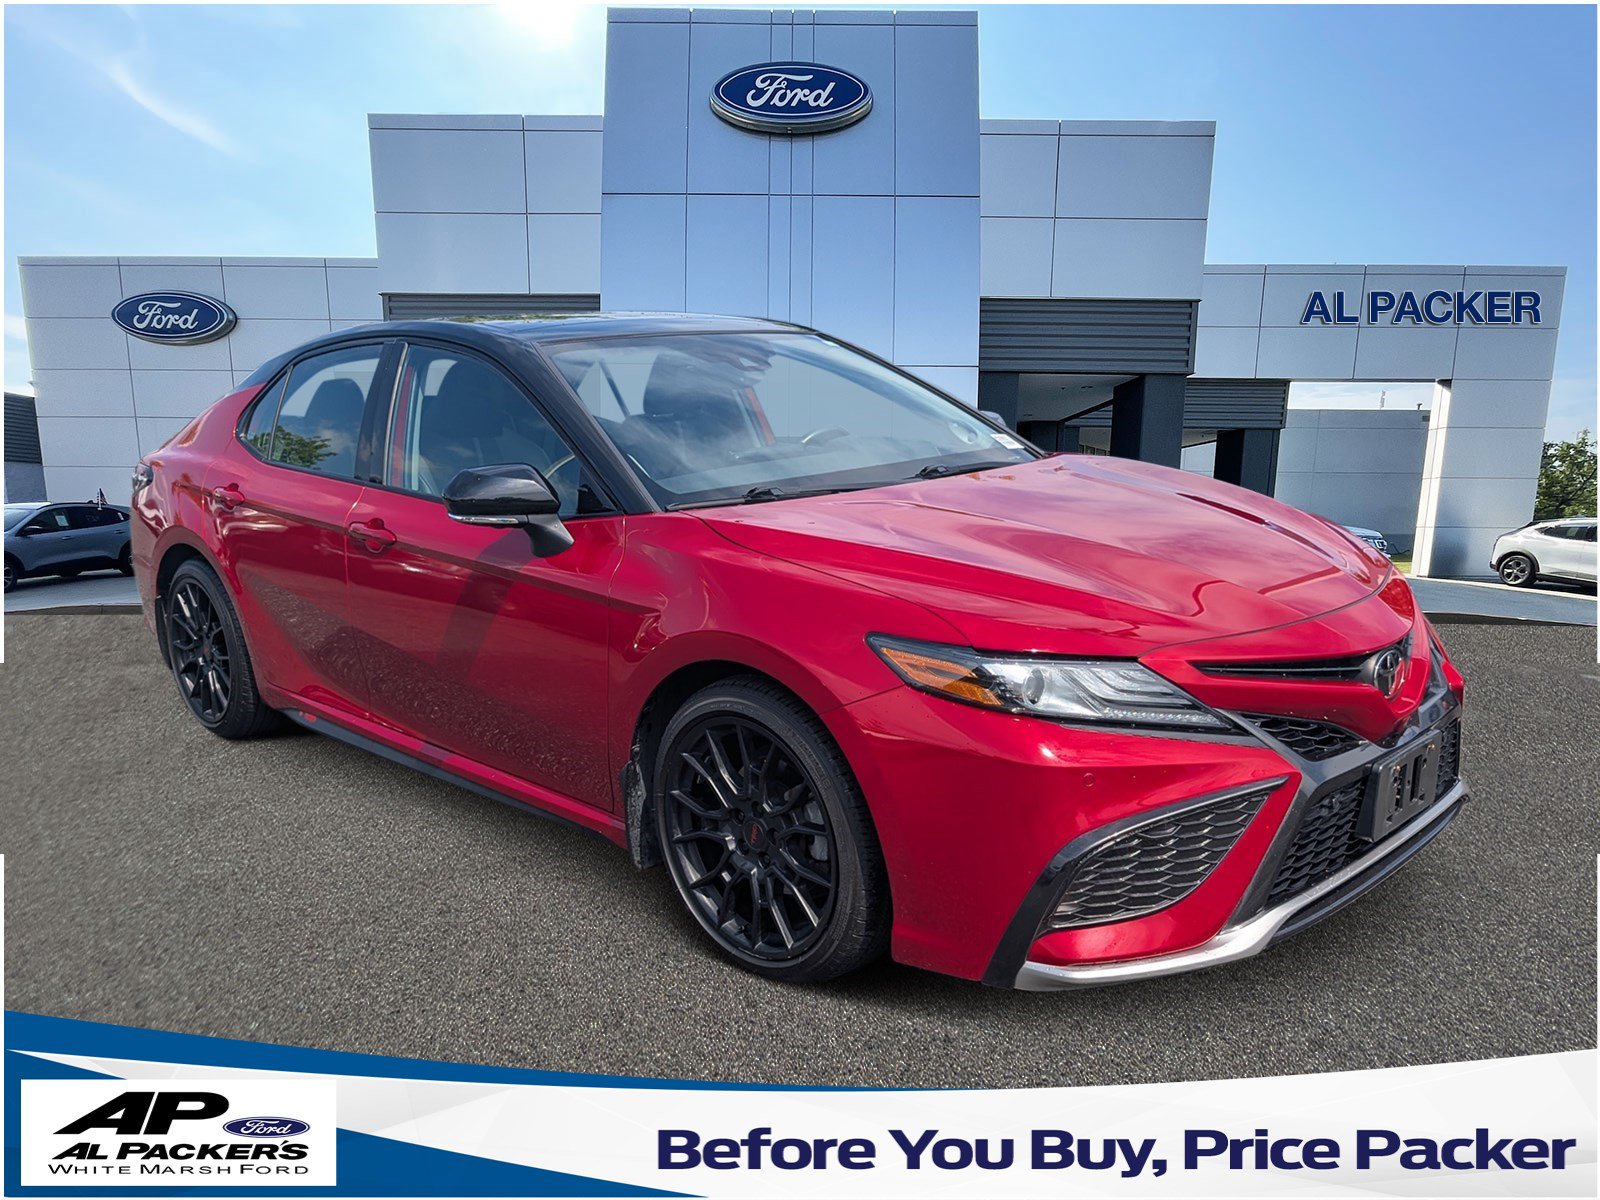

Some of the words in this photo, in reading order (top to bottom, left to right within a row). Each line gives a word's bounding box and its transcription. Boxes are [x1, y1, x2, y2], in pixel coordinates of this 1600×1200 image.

[746, 73, 836, 107] Ford
[133, 301, 199, 329] Ford
[1301, 291, 1359, 324] AL
[1369, 290, 1541, 324] PACKER
